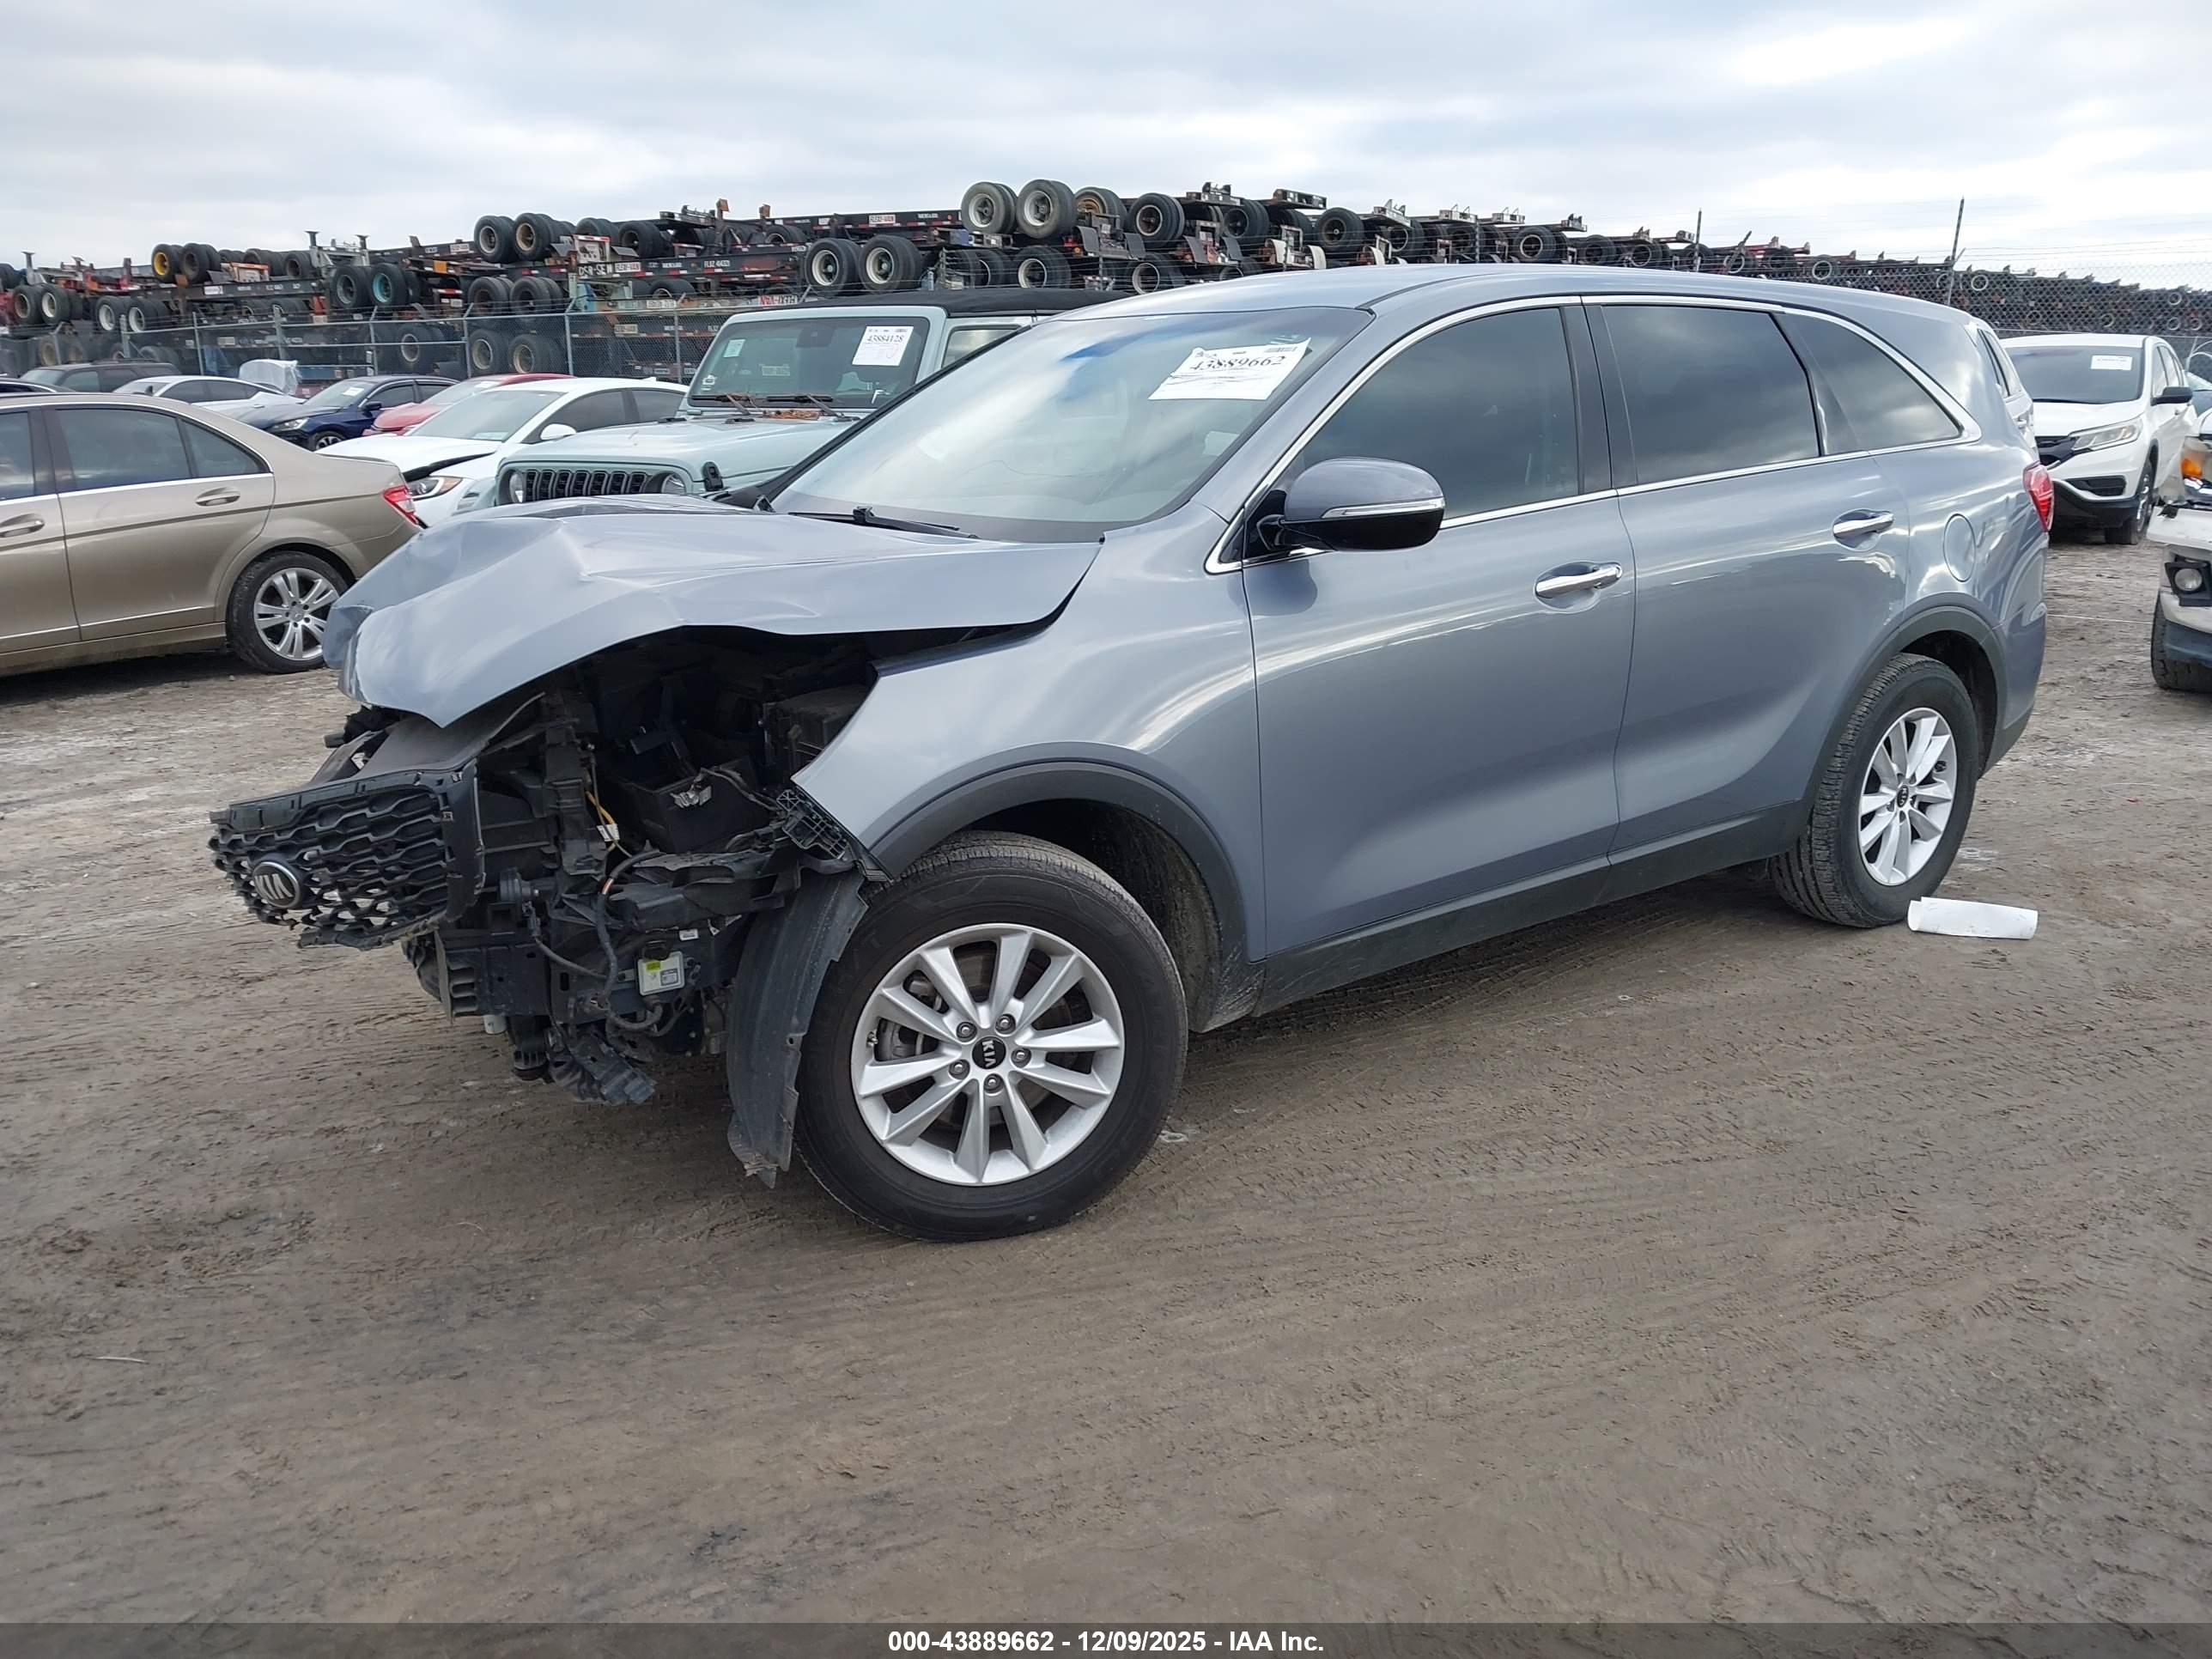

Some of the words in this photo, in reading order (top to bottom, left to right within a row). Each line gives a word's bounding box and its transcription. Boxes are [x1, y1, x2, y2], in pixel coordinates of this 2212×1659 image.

[1190, 355, 1285, 371] 43889662
[255, 873, 294, 900] KIA
[981, 1039, 997, 1067] KIA
